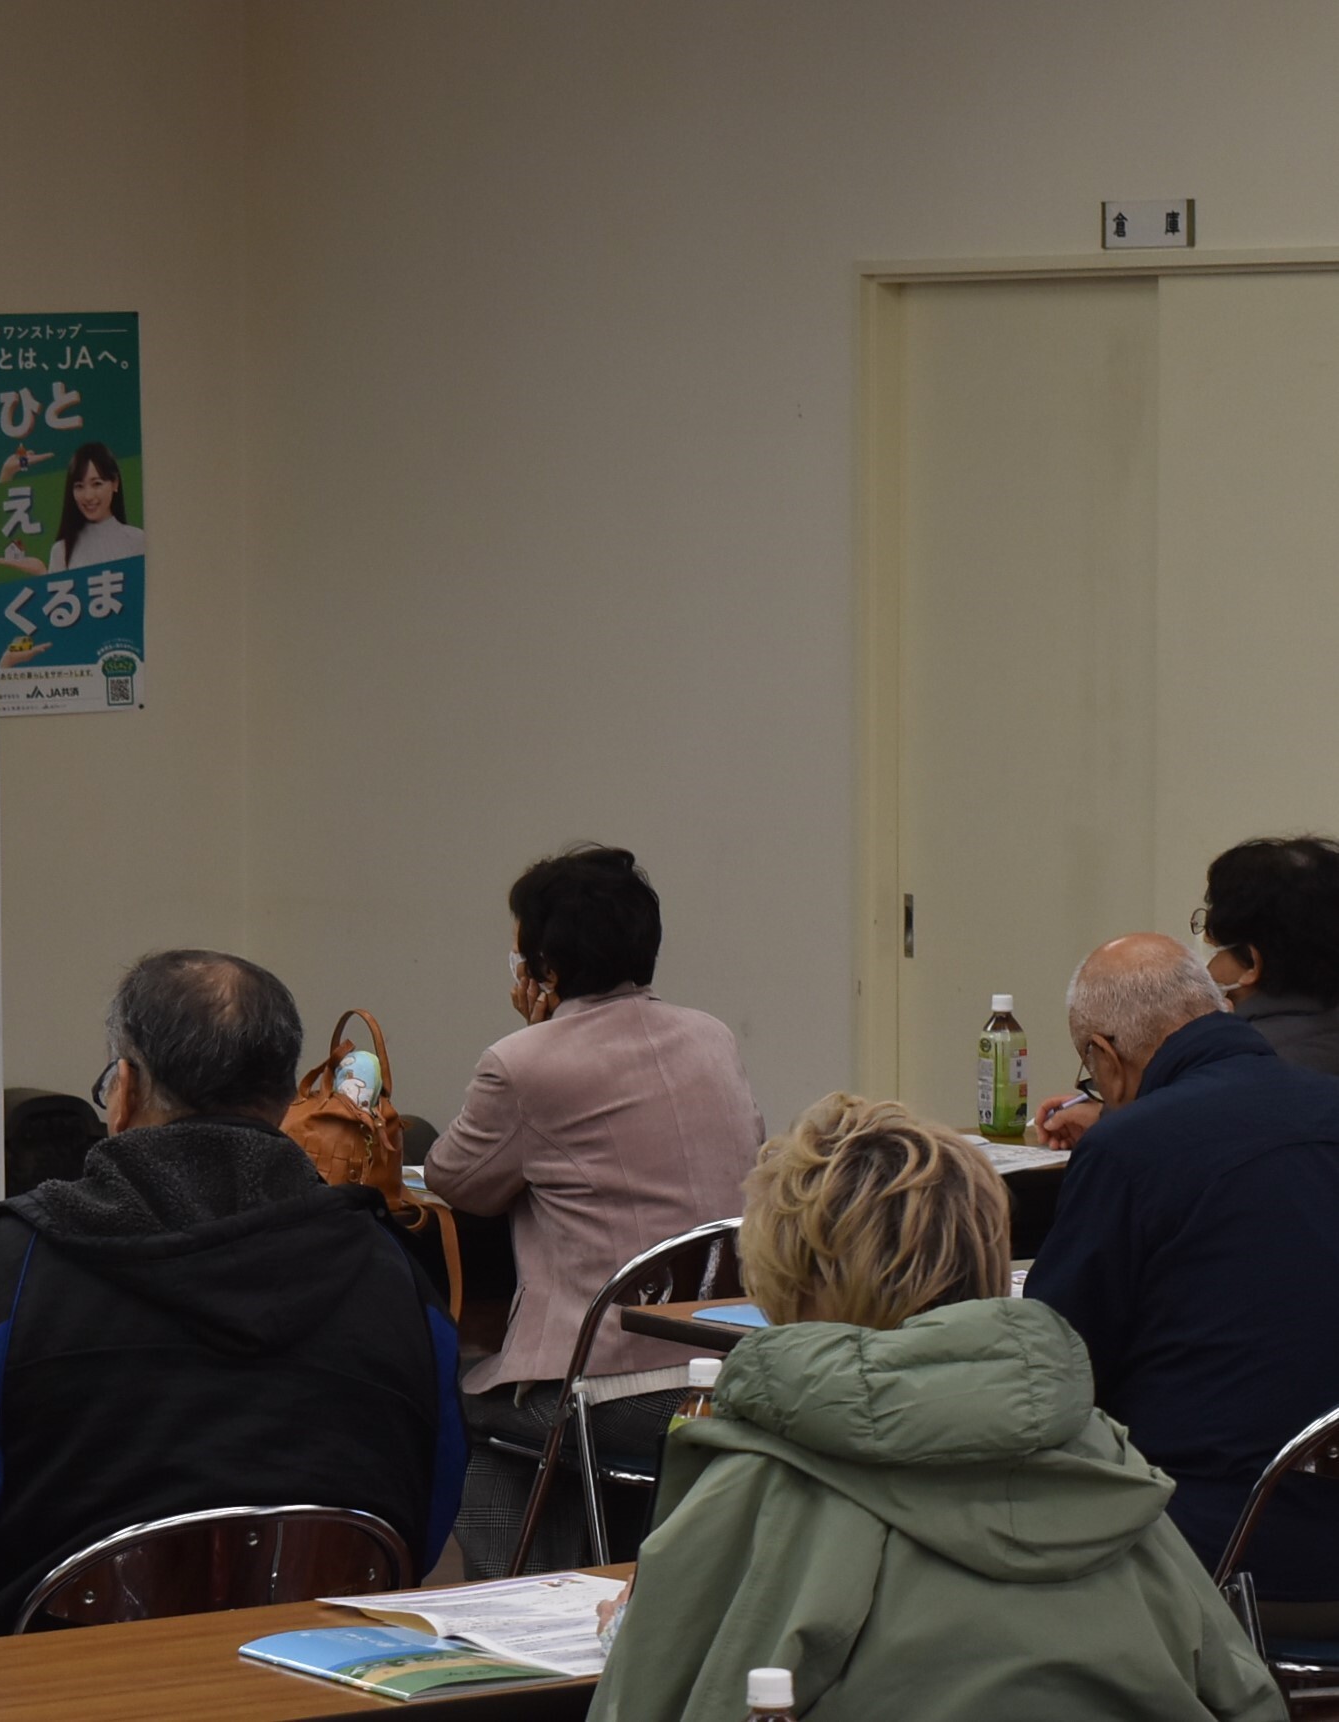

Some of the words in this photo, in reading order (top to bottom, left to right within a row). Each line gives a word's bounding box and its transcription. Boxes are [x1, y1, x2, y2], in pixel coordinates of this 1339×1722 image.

[1113, 210, 1181, 238] 倉庫
[0, 382, 83, 438] ひと
[4, 570, 125, 636] くるま
